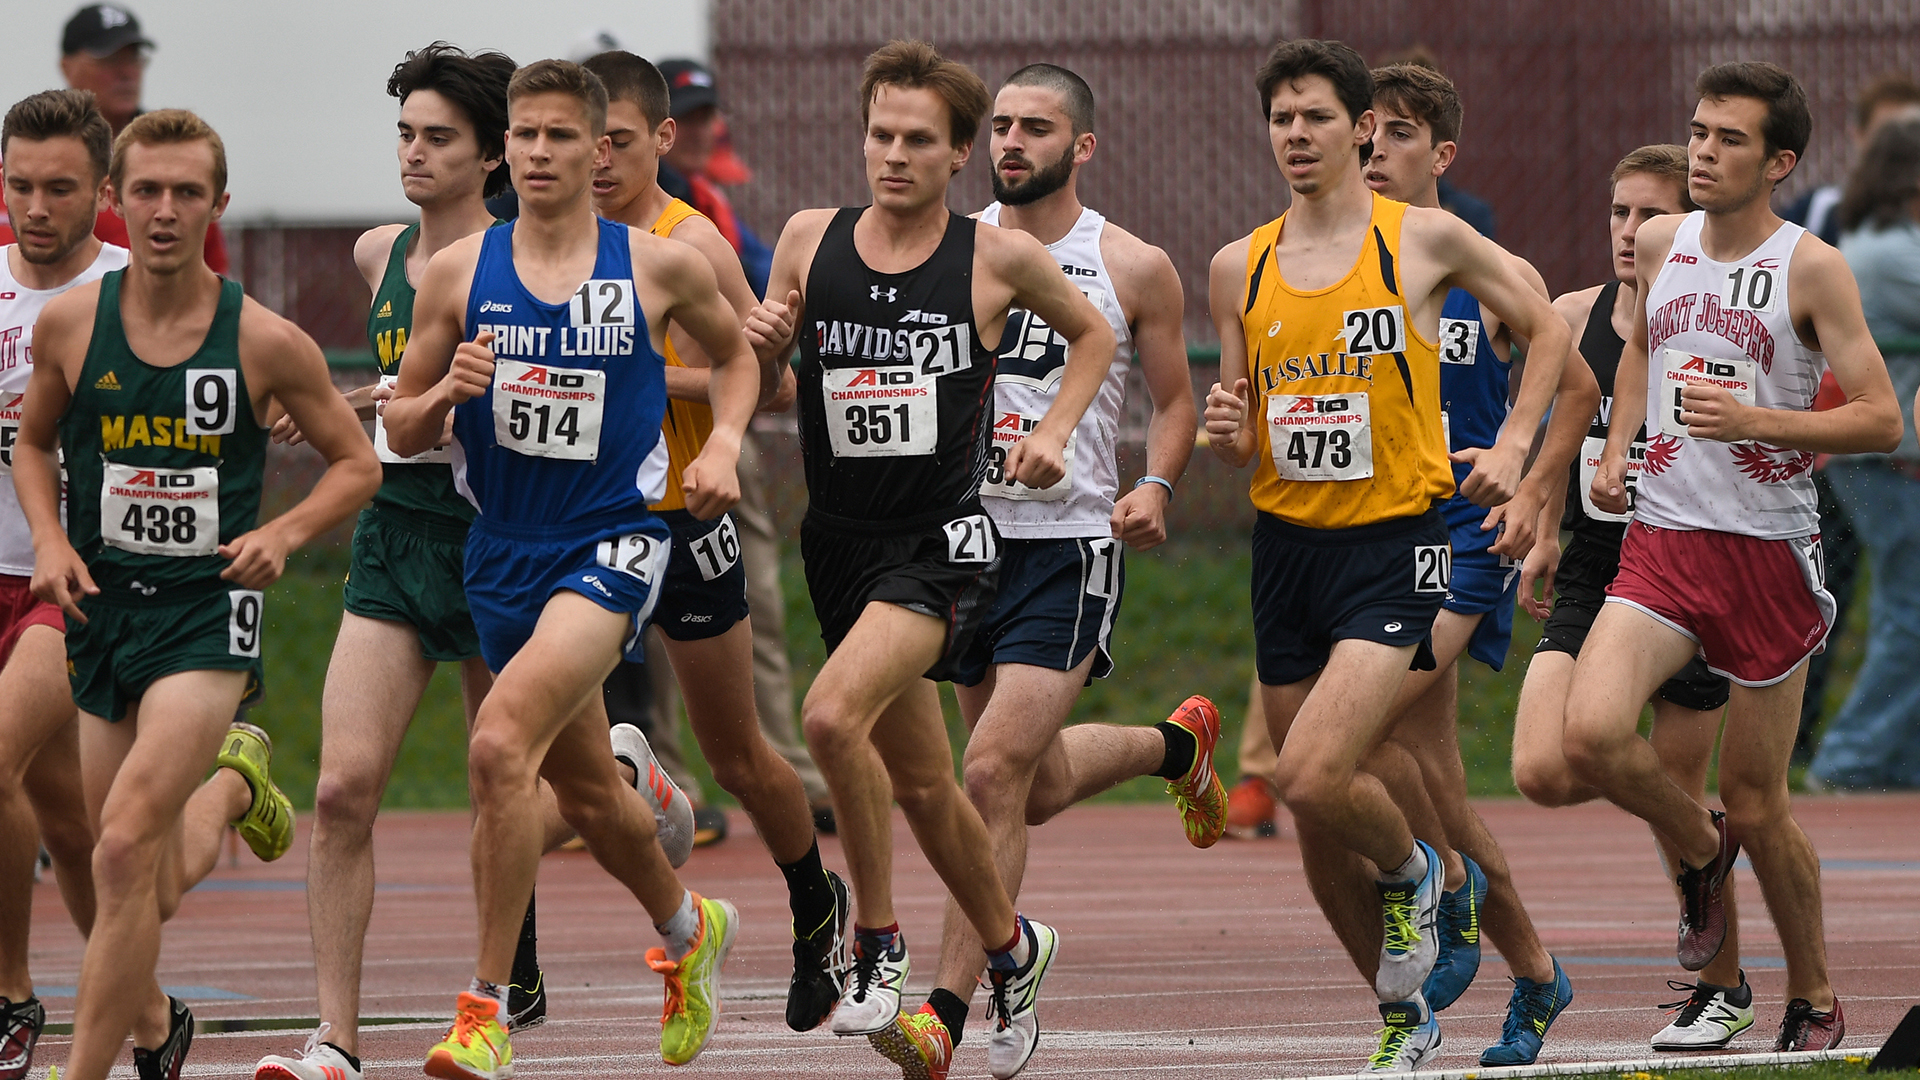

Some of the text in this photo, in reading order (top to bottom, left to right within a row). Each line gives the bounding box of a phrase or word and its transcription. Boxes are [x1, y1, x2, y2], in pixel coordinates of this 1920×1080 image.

[1668, 253, 1698, 265] A10
[575, 282, 625, 325] 12
[1728, 267, 1773, 310] 10
[898, 309, 948, 325] A10
[1346, 308, 1397, 354] 20
[560, 326, 635, 356] LOUIS
[816, 320, 910, 361] DAVIDS
[916, 326, 960, 376] 21
[1445, 321, 1470, 362] 3
[517, 365, 585, 388] A10
[846, 369, 914, 388] A10
[1680, 354, 1736, 377] A10
[193, 374, 229, 431] 9
[501, 382, 595, 402] CHAMPIONSHIPS
[831, 387, 928, 401] CHAMPIONSHIPS
[1286, 396, 1349, 414] A10
[101, 414, 222, 457] MASON
[509, 399, 580, 446] 514
[845, 403, 911, 445] 351
[1273, 413, 1362, 426] CHAMPIONSHIPS
[1286, 429, 1352, 469] 473
[109, 486, 209, 501] CHAMPIONSHIPS
[125, 470, 195, 488] A10
[121, 503, 197, 545] 438
[950, 517, 987, 560] 21
[603, 535, 651, 579] 12
[696, 523, 737, 576] 16
[1417, 547, 1449, 590] 20
[236, 595, 259, 653] 9
